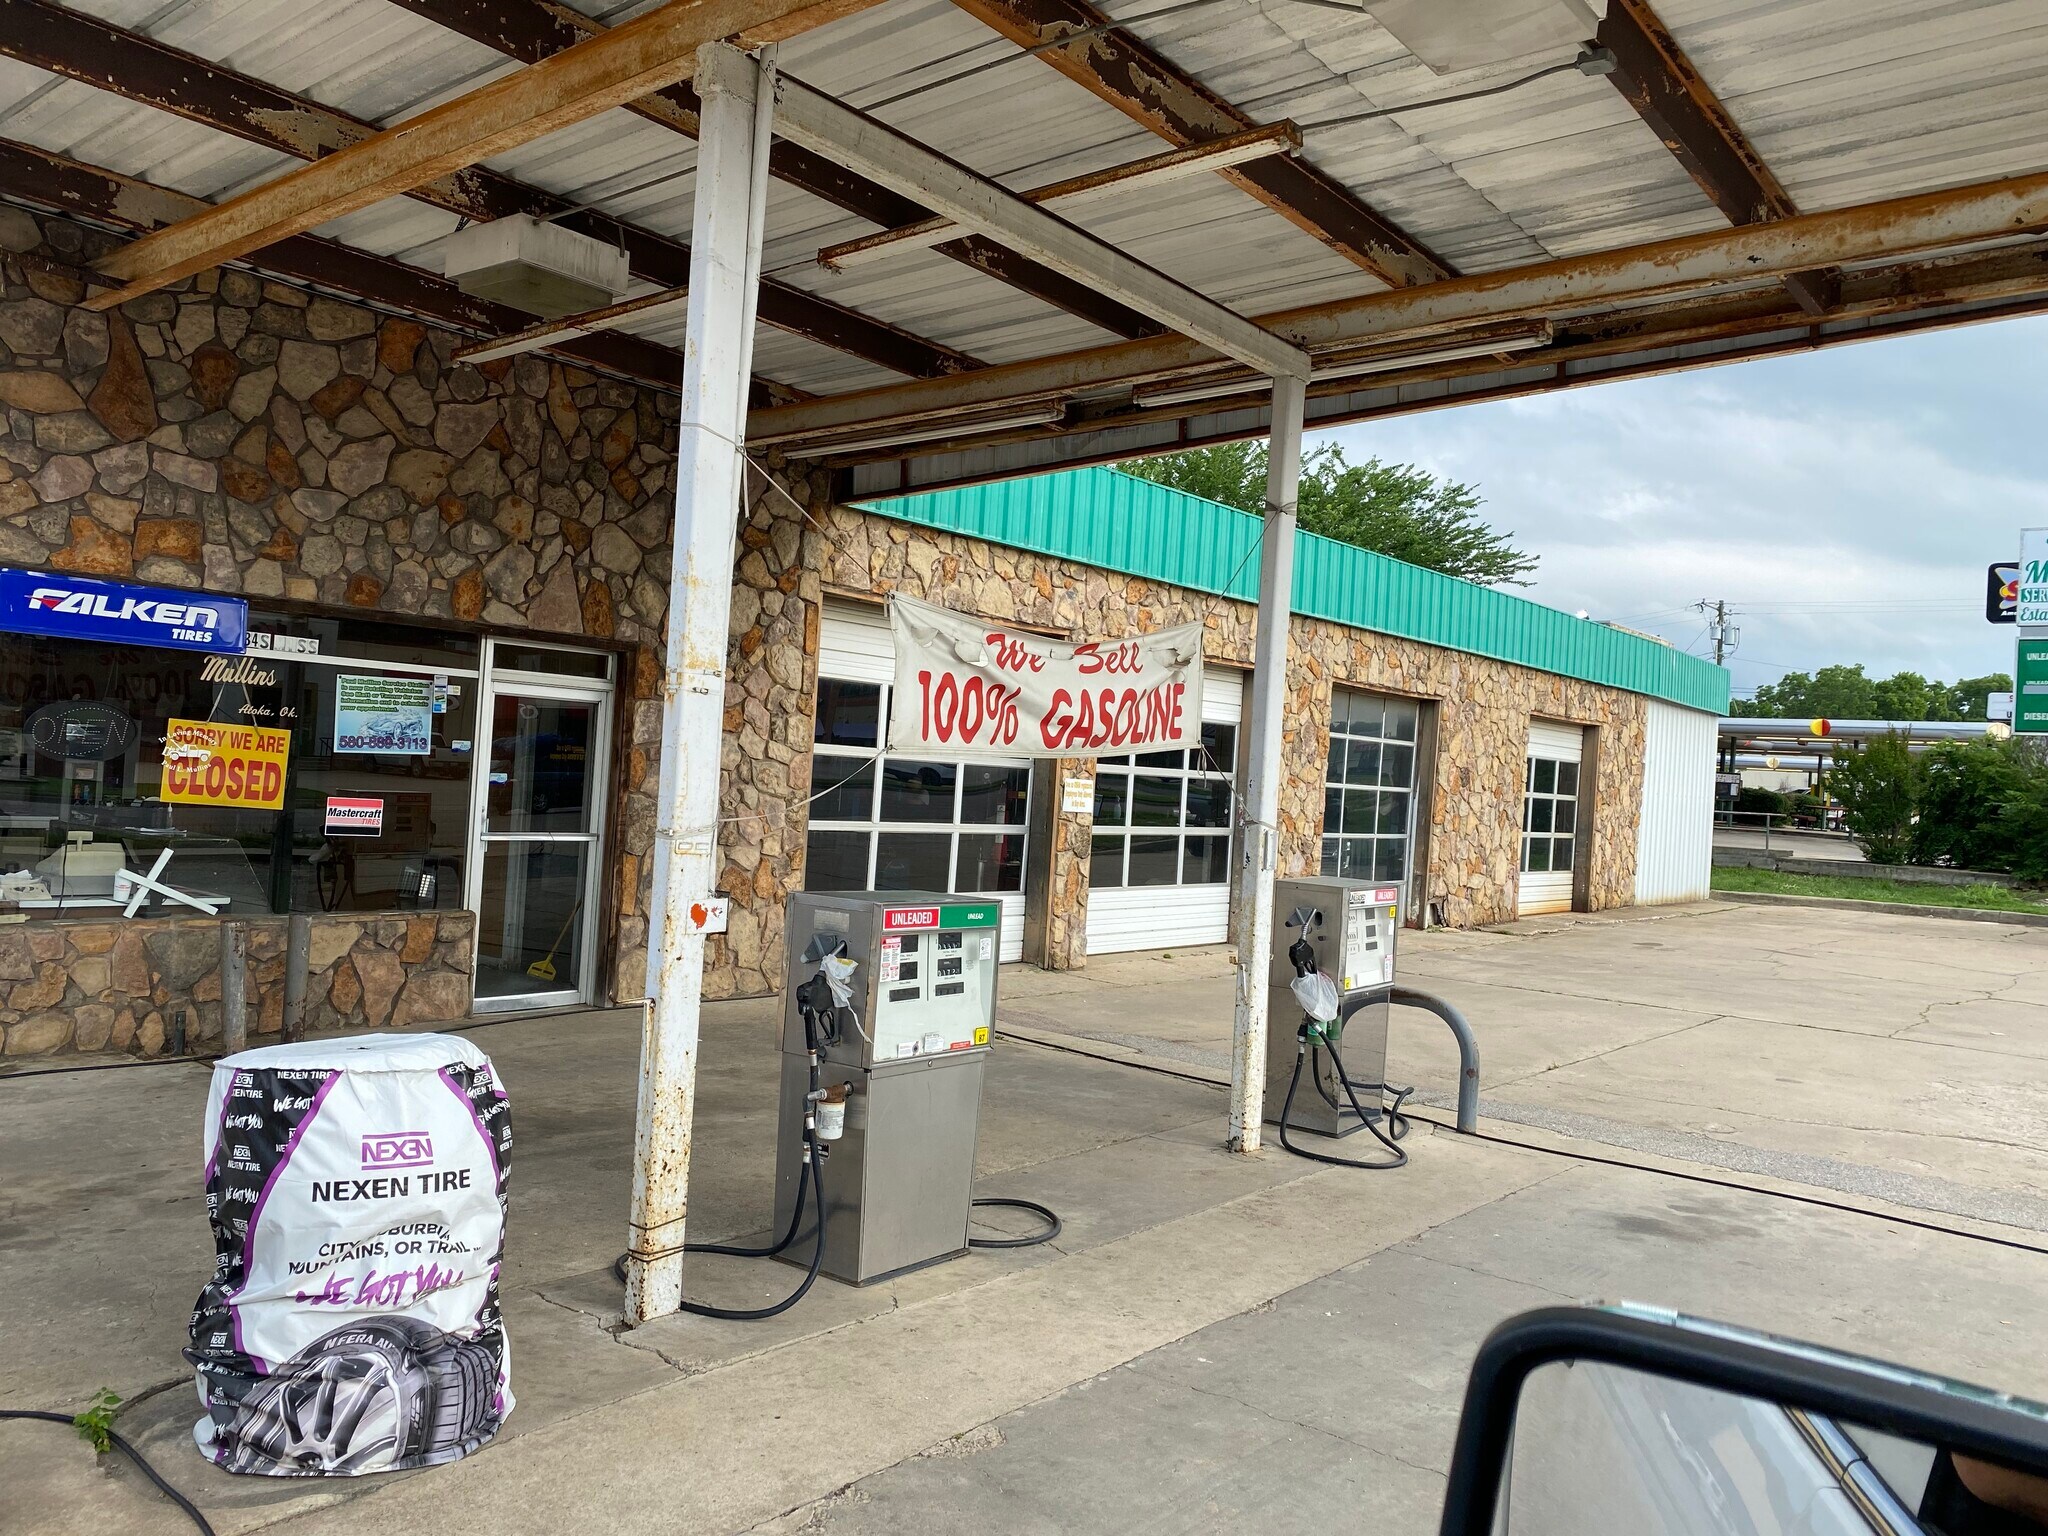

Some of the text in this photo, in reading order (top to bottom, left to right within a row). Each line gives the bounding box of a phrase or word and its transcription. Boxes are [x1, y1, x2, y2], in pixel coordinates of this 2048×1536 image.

[25, 588, 219, 628] FALKEN
[172, 628, 213, 643] TIRES
[986, 634, 1144, 675] We Sell
[200, 655, 276, 686] Mullins
[238, 704, 298, 718] Atoka, Ok.
[918, 670, 1185, 750] 100% GASOLINE
[32, 717, 129, 745] OPEN
[167, 730, 191, 738] Loving
[193, 730, 217, 746] Memory
[174, 725, 286, 754] SORRY WE ARE
[161, 759, 176, 771] Paul
[186, 763, 212, 773] Mullins
[168, 755, 282, 801] CLOSED
[327, 808, 381, 818] Mastercraft
[892, 912, 933, 926] UNLEADED
[277, 1071, 308, 1079] NEXEN
[273, 1095, 294, 1112] WE
[362, 1138, 433, 1163] NEXEN
[245, 1162, 261, 1171] TIRE
[312, 1168, 471, 1202] NEXEN TIRE
[395, 1241, 422, 1255] OR
[353, 1270, 414, 1307] GOT
